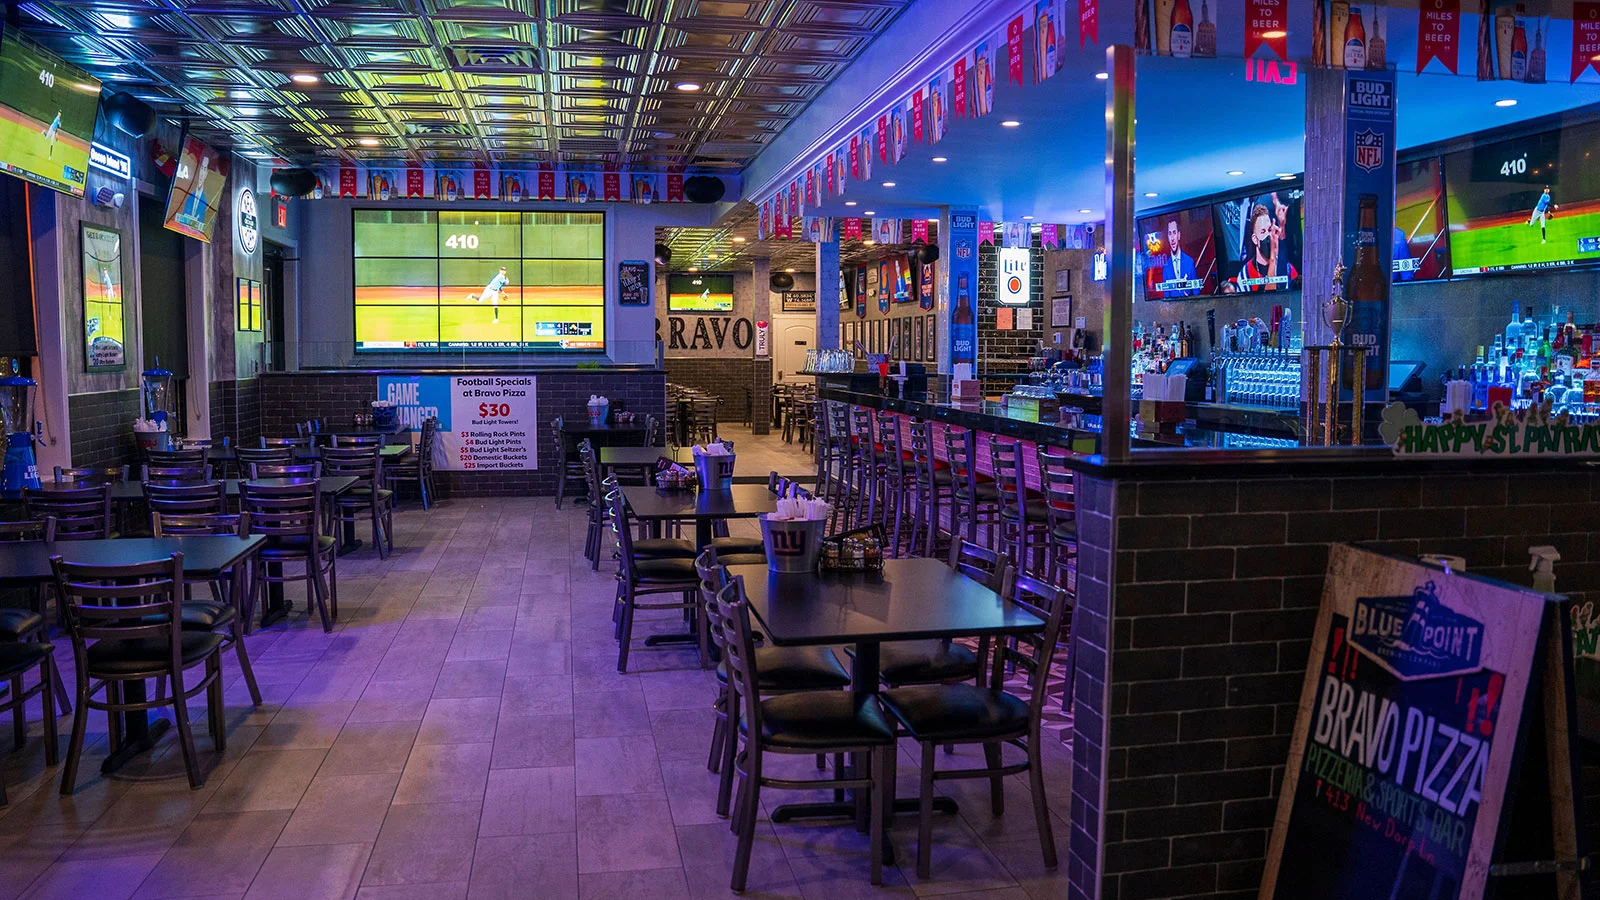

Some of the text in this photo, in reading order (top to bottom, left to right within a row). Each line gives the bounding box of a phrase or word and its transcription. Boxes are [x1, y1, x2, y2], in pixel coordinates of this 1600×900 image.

[1082, 8, 1095, 22] BEER
[1260, 8, 1272, 16] TO
[1426, 12, 1452, 20] MILES
[1252, 20, 1279, 28] BEER
[1432, 23, 1444, 31] TO
[1425, 33, 1451, 42] BEER
[1586, 33, 1598, 41] TO
[39, 69, 54, 88] 410
[1356, 81, 1385, 94] BUD
[1350, 92, 1390, 107] LIGHT
[1357, 147, 1380, 167] NFL
[1500, 158, 1526, 176] 410
[446, 235, 479, 249] 410
[957, 248, 970, 258] NFL
[1352, 333, 1377, 346] BUD
[457, 378, 532, 387] Football Specials
[388, 383, 419, 405] GAME
[479, 402, 510, 418] $30
[1406, 424, 1486, 453] HAPPY
[1355, 602, 1478, 662] BLUE POINT
[1314, 675, 1490, 817] BRAVO PIZZA
[1305, 743, 1363, 800] PIZZERIA
[1430, 809, 1466, 858] BAR
[1326, 787, 1351, 811] 413
[1356, 803, 1382, 830] New
[1385, 819, 1415, 858] Dorp
